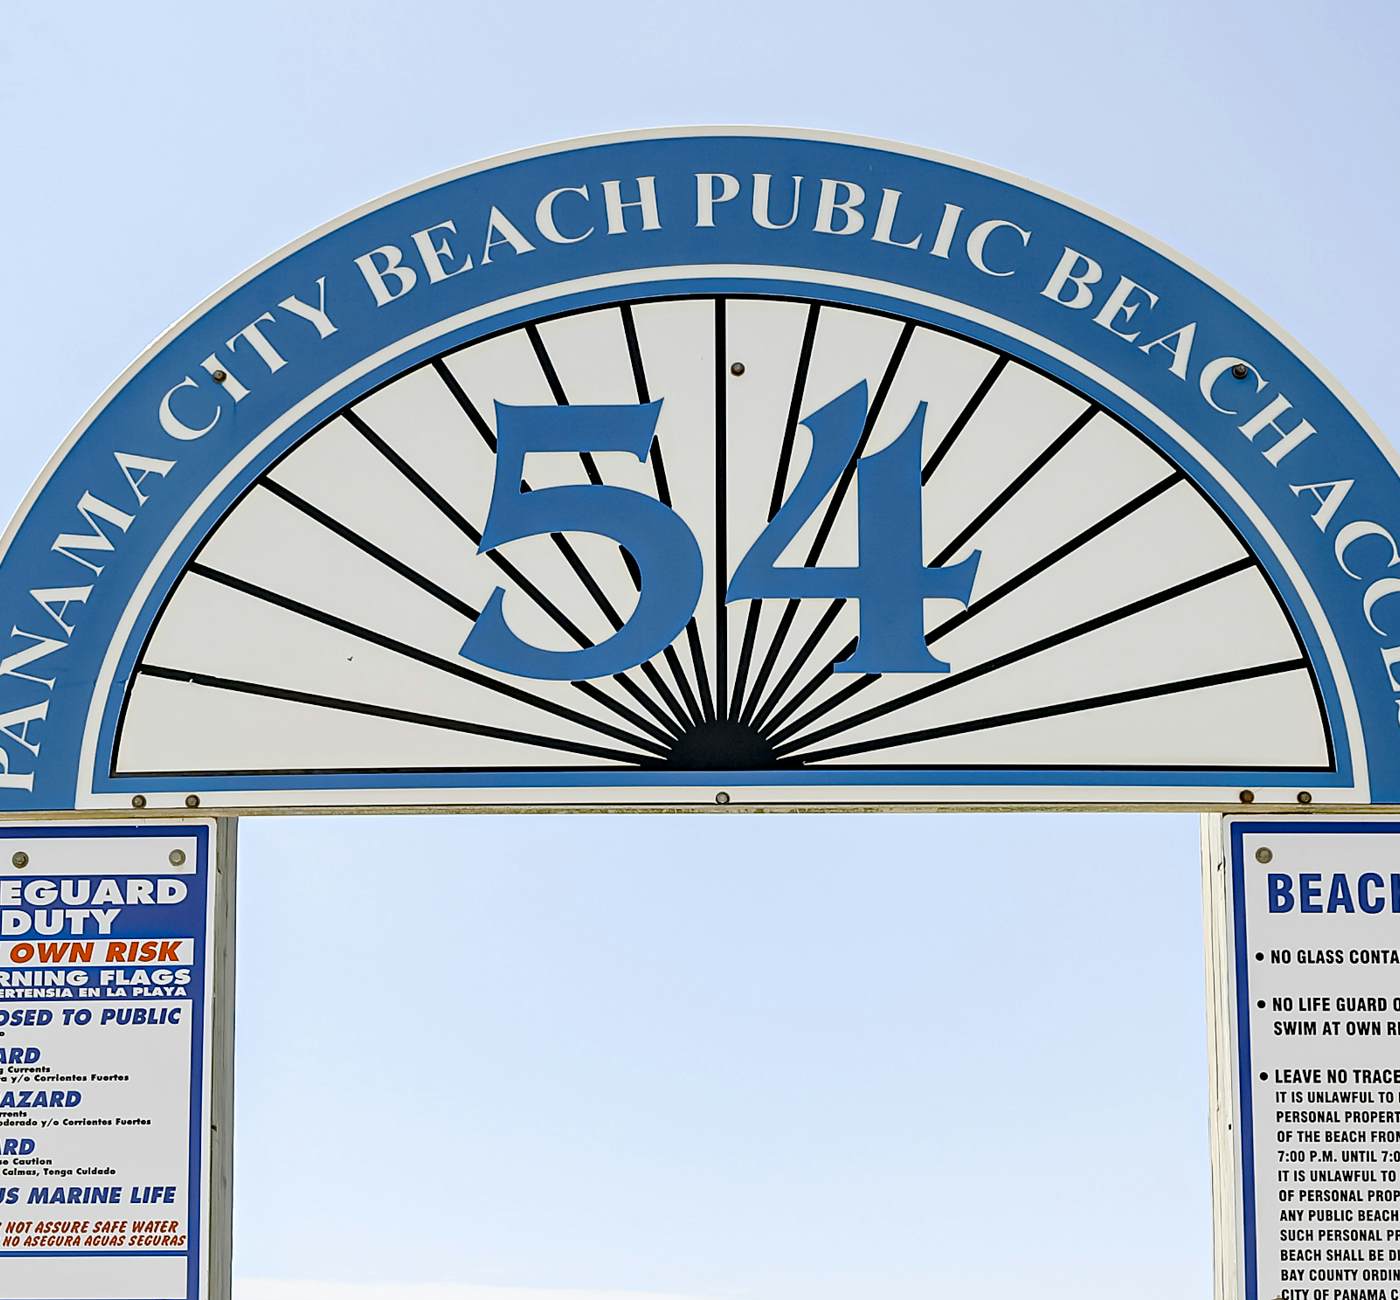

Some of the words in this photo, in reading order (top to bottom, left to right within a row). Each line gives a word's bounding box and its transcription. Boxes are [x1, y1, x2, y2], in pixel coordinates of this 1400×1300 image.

[0, 450, 177, 793] PANAMA
[158, 277, 339, 441] CITY
[354, 176, 661, 308] BEACH
[696, 172, 1032, 277] PUBLIC
[1040, 246, 1318, 468] BEACH
[458, 378, 982, 681] 54
[0, 879, 188, 905] EGUARD
[1, 908, 121, 936] DUTY
[10, 942, 95, 963] OWN
[105, 941, 183, 963] RISK
[1271, 950, 1291, 964] NO
[1297, 950, 1344, 964] GLASS
[1350, 950, 1400, 964] CONTA
[101, 969, 191, 985] FLAGS
[79, 988, 99, 997] EN
[107, 987, 126, 996] LA
[133, 986, 186, 996] PLAYA
[1273, 998, 1293, 1011] NO
[1299, 998, 1331, 1011] LIFE
[1336, 998, 1387, 1011] GUARD
[63, 1009, 92, 1026] TO
[101, 1007, 181, 1025] PUBLIC
[1274, 1022, 1317, 1035] SWIM
[1323, 1022, 1340, 1035] AT
[1346, 1021, 1381, 1035] OWN
[34, 1074, 87, 1082] Corrientes
[1275, 1070, 1321, 1083] LEAVE
[1328, 1070, 1347, 1083] NO
[1353, 1070, 1400, 1083] TRACE
[0, 1091, 82, 1108] AZARD
[1276, 1092, 1287, 1103] IT
[1292, 1092, 1303, 1103] IS
[1308, 1092, 1374, 1103] UNLAWFUL
[1378, 1092, 1394, 1103] TO
[63, 1118, 112, 1126] Corrientes
[1276, 1111, 1340, 1123] PERSONAL
[1345, 1111, 1400, 1123] PROPERT
[1277, 1131, 1293, 1142] OF
[1297, 1131, 1320, 1142] THE
[1325, 1131, 1366, 1142] BEACH
[1278, 1151, 1305, 1162] 7:00
[1310, 1151, 1337, 1162] P.M.
[1342, 1151, 1377, 1162] UNTIL
[3, 1168, 39, 1176] Calmas,
[43, 1168, 73, 1177] Tenga
[77, 1167, 116, 1175] Cuidado
[1278, 1170, 1289, 1182] IT
[1294, 1170, 1305, 1182] IS
[1310, 1170, 1377, 1182] UNLAWFUL
[1381, 1170, 1396, 1182] TO
[27, 1187, 122, 1204] MARINE
[130, 1186, 176, 1203] LIFE
[1279, 1190, 1294, 1201] OF
[1299, 1190, 1363, 1201] PERSONAL
[1367, 1190, 1400, 1201] PROP
[1280, 1210, 1304, 1221] ANY
[1308, 1210, 1353, 1221] PUBLIC
[1358, 1210, 1399, 1221] BEACH
[5, 1221, 33, 1233] NOT
[35, 1221, 89, 1233] ASSURE
[93, 1221, 128, 1233] SAFE
[132, 1220, 179, 1232] WATER
[3, 1236, 20, 1246] NO
[24, 1236, 80, 1246] ASEGURA
[84, 1235, 125, 1246] AGUAS
[128, 1235, 185, 1246] SEGURAS
[1280, 1229, 1314, 1241] SUCH
[1318, 1229, 1382, 1241] PERSONAL
[1280, 1249, 1321, 1261] BEACH
[1326, 1249, 1365, 1261] SHALL
[1369, 1249, 1384, 1261] BE
[1281, 1269, 1305, 1281] BAY
[1309, 1269, 1358, 1281] COUNTY
[1363, 1269, 1400, 1281] ORDIN
[1281, 1289, 1309, 1300] CITY
[1313, 1289, 1329, 1300] OF
[1334, 1289, 1387, 1300] PANAMA
